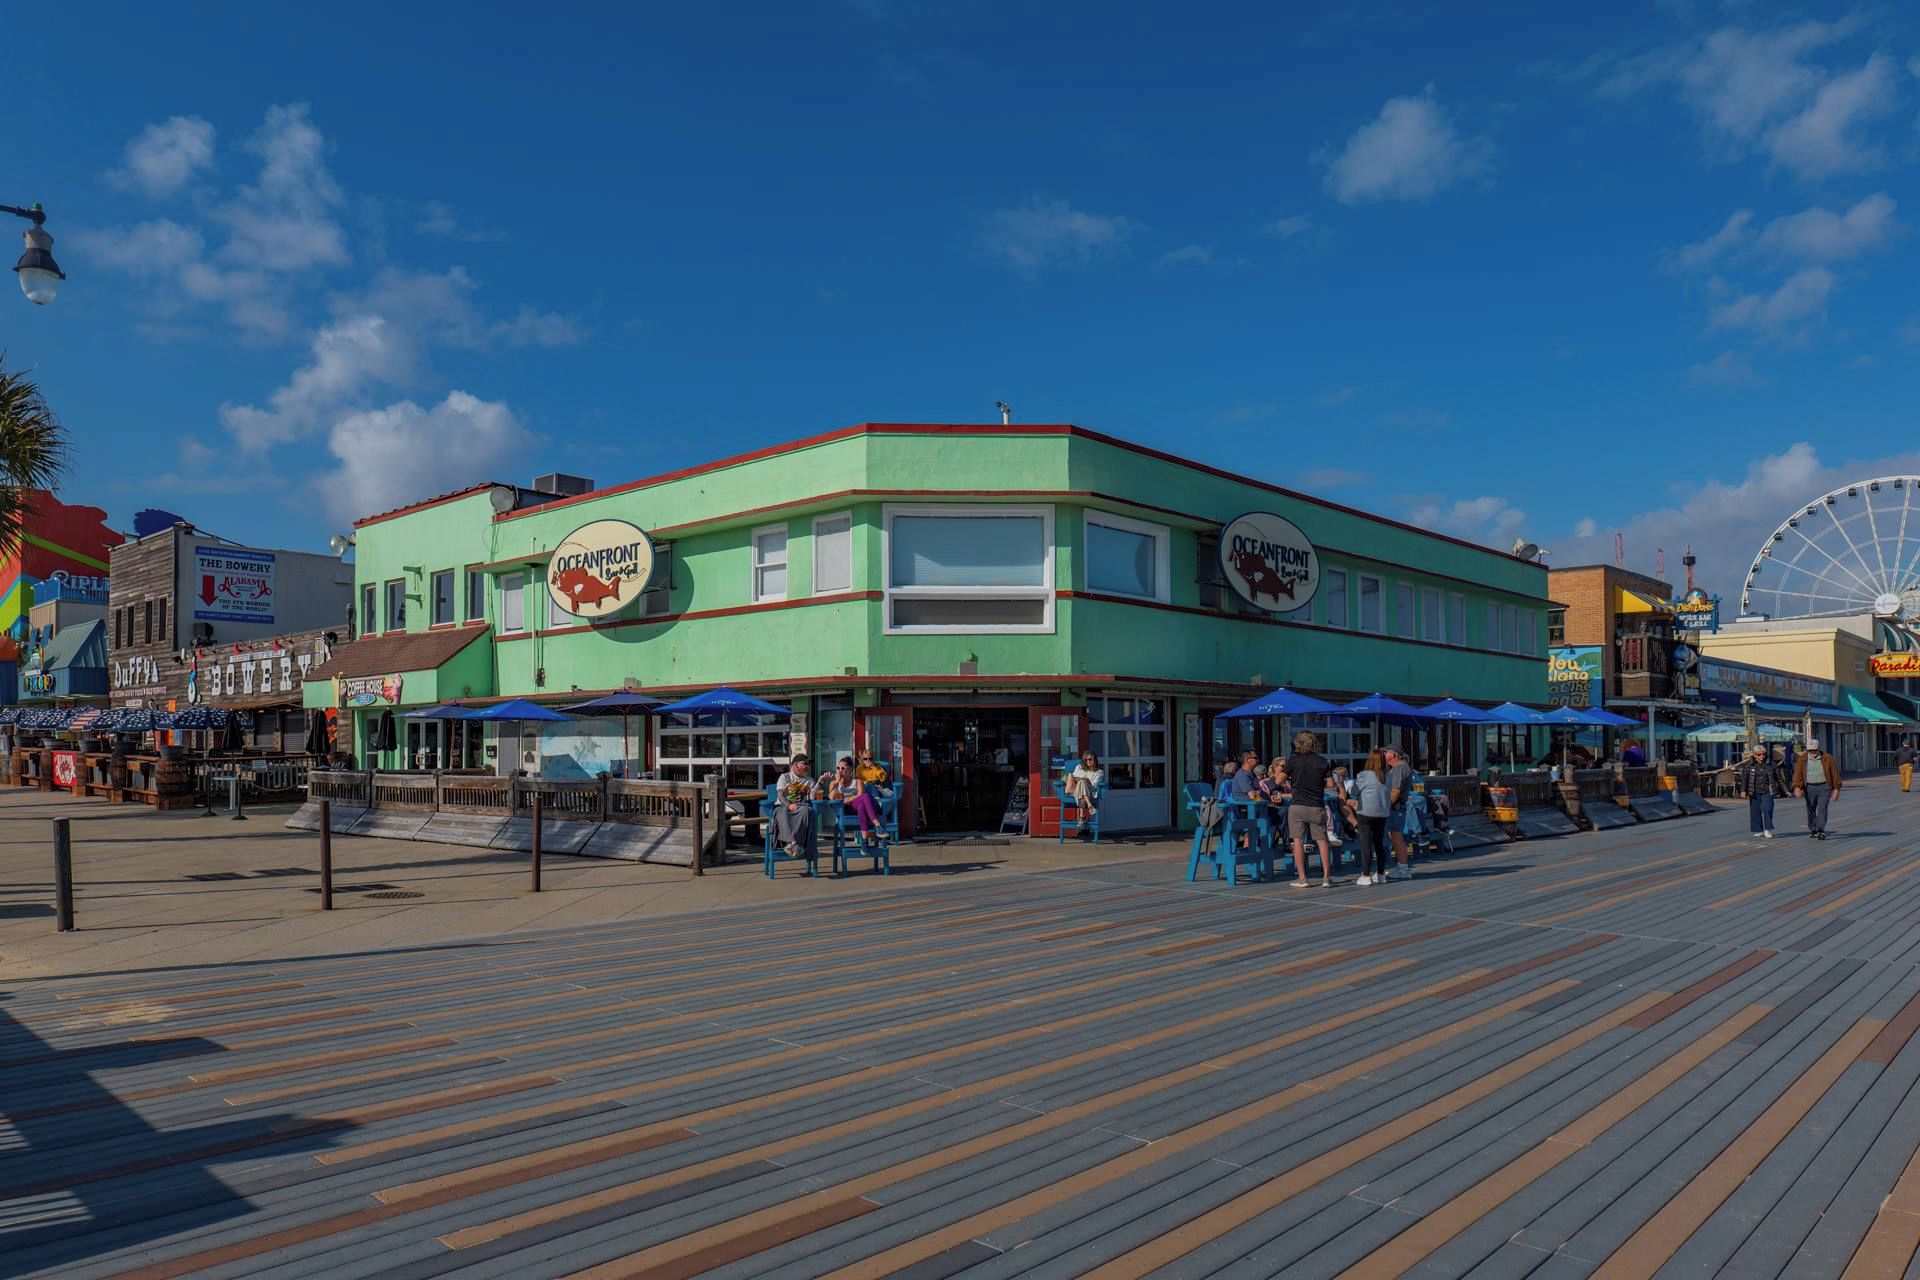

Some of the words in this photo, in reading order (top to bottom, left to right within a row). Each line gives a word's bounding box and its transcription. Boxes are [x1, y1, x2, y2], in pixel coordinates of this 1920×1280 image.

[557, 542, 641, 578] OCEANFRONT
[1232, 534, 1311, 573] OCEANFRONT
[200, 558, 223, 569] THE
[225, 561, 271, 573] BOWERY
[624, 562, 638, 578] Grill
[50, 569, 110, 592] RIPLE
[211, 653, 311, 696] BOWERY
[1871, 656, 1920, 676] Paradi
[1548, 669, 1589, 684] long
[347, 681, 366, 697] COFFEE
[366, 679, 383, 696] HOUSE
